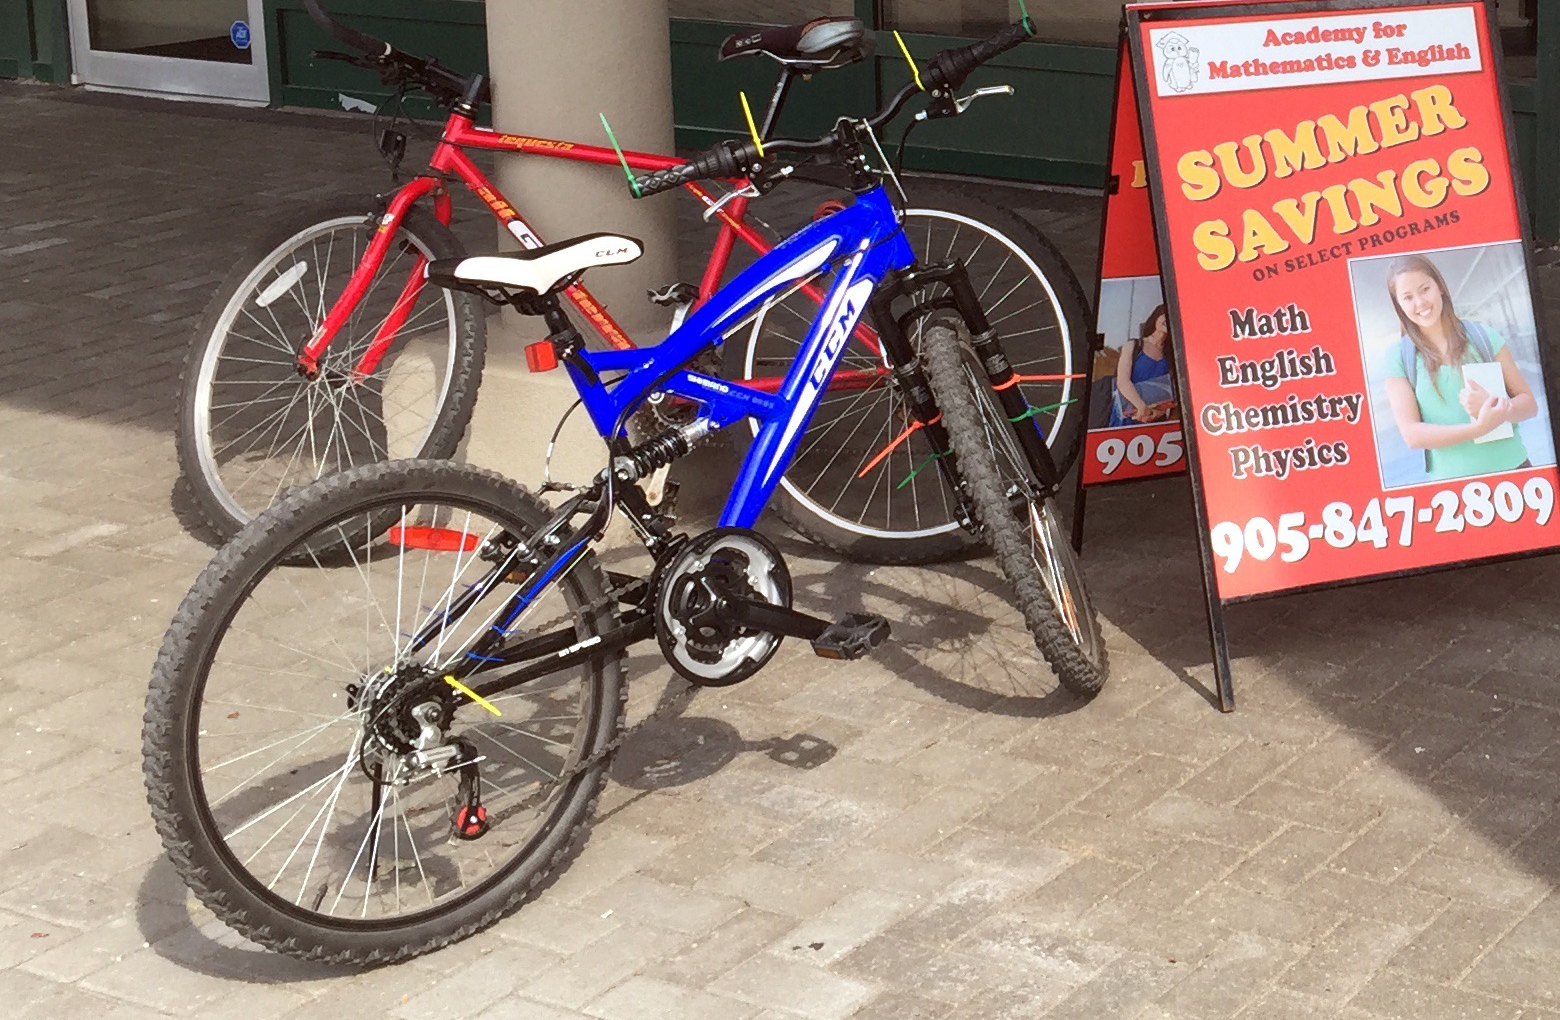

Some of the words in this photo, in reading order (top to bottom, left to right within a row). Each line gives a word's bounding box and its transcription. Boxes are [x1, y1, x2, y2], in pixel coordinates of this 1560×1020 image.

[1263, 25, 1367, 48] Academy
[1372, 21, 1407, 40] for
[1208, 52, 1357, 80] Mathematics
[1361, 50, 1381, 67] &
[1387, 43, 1471, 69] English
[1176, 84, 1468, 201] SUMMER
[1193, 146, 1492, 272] SAVINGS
[1252, 261, 1286, 282] ON
[1289, 241, 1354, 273] SELECT
[1359, 210, 1461, 252] PROGRAMS
[1228, 303, 1312, 340] Math
[1217, 344, 1336, 389] English
[1200, 391, 1364, 435] Chemistry
[1097, 431, 1183, 474] 905
[1231, 438, 1351, 480] Physics
[1210, 475, 1556, 574] 905-847-2809
